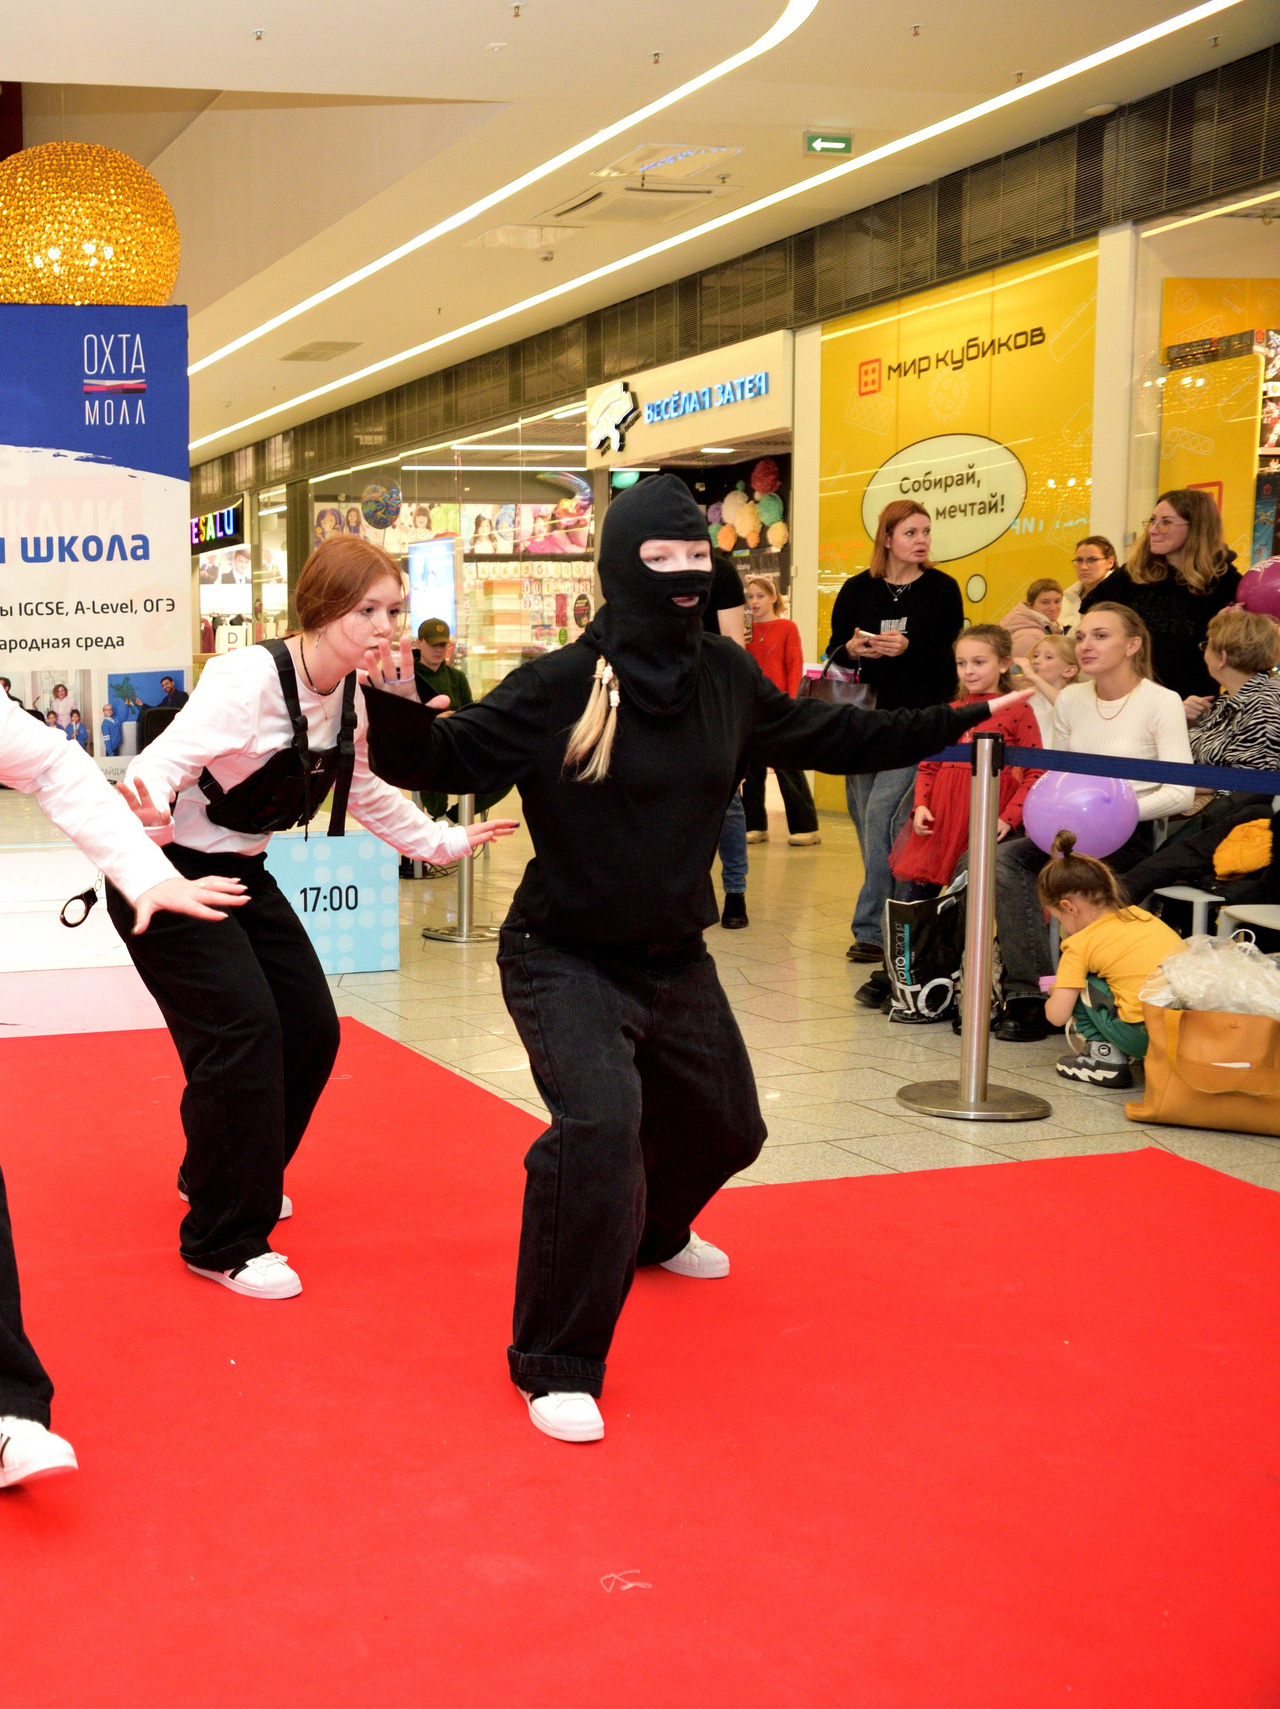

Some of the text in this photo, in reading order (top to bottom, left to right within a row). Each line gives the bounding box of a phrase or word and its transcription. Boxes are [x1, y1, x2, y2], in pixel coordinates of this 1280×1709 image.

[83, 333, 146, 375] ОХТА
[936, 326, 1046, 371] кубиков
[644, 386, 712, 424] ВЕСЁЛАЯ
[714, 371, 769, 406] ЗАТЕЯ
[85, 400, 146, 425] МОЛЛ
[900, 464, 981, 494] Собирай,
[935, 493, 1006, 521] мечтай!
[21, 533, 151, 562] школа
[18, 601, 69, 617] IGCSE,
[74, 599, 138, 616] A-Level,
[144, 598, 175, 613] ОГЭ
[76, 634, 125, 651] среда
[300, 885, 358, 912] 17:00
